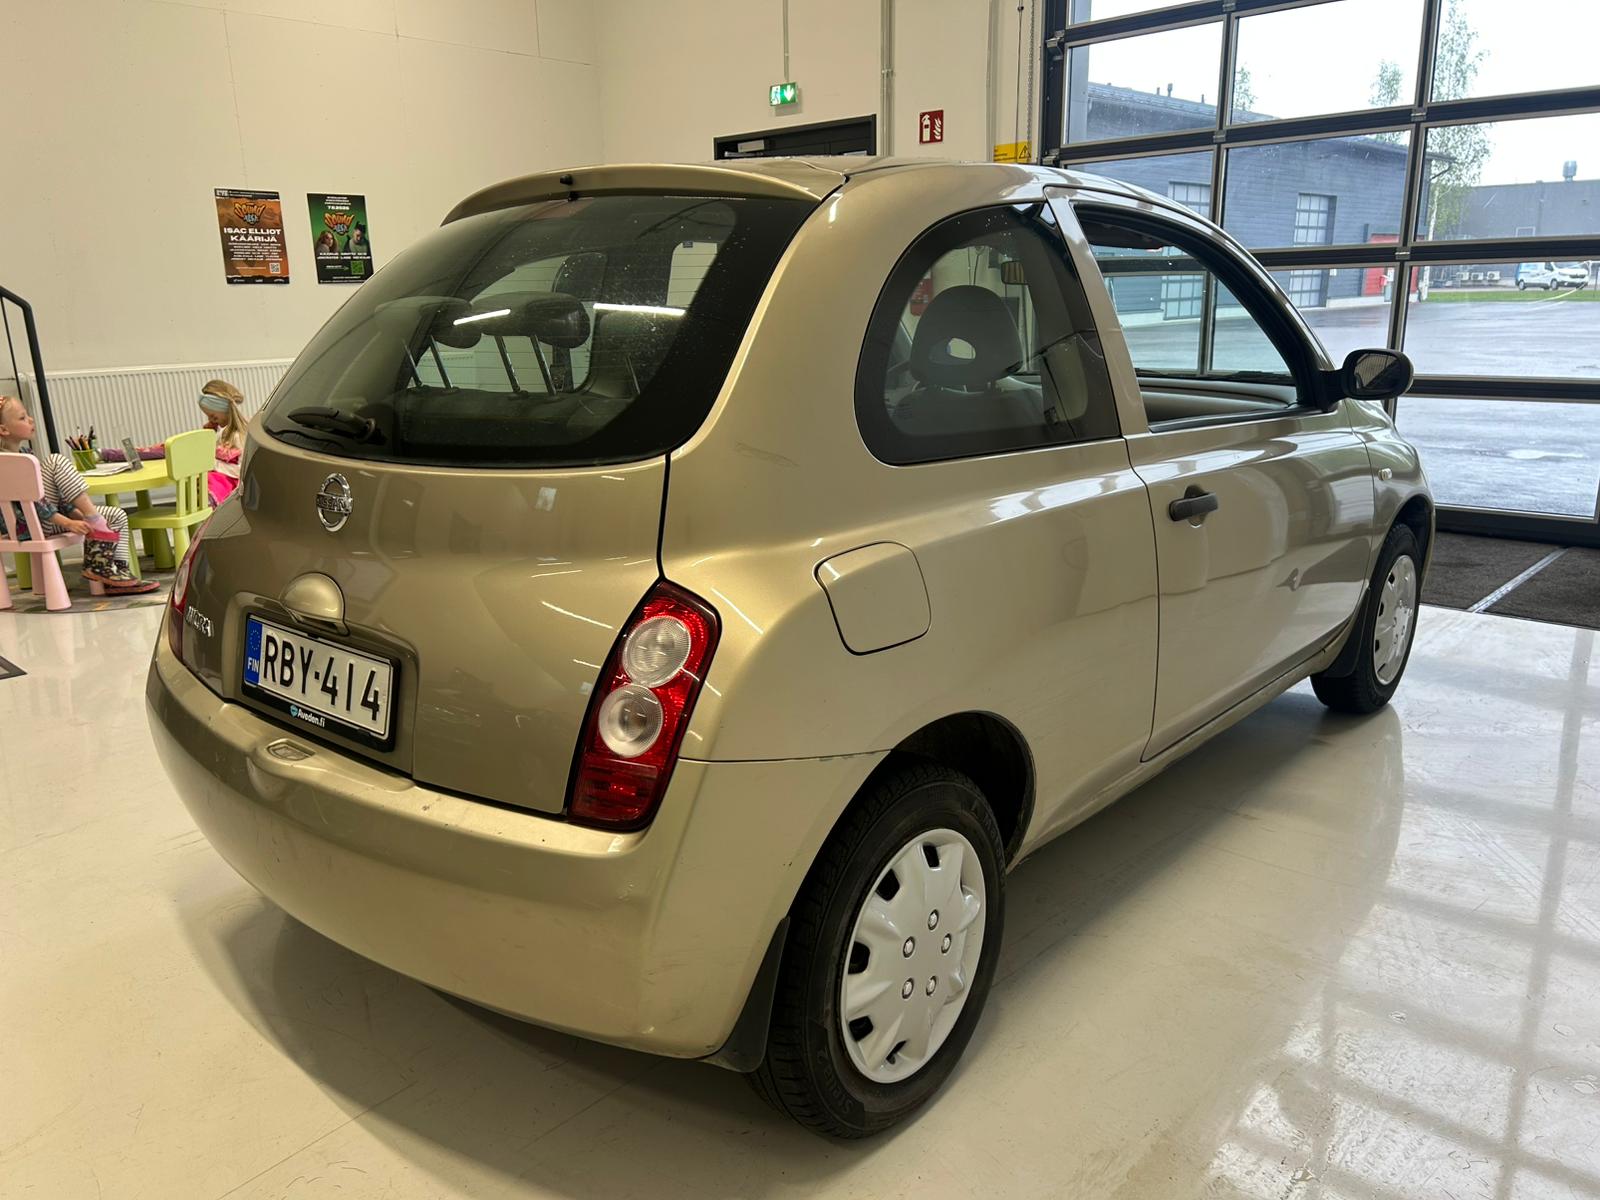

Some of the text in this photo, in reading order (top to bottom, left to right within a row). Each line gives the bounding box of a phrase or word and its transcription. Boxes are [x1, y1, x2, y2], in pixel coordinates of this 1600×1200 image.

[230, 233, 277, 242] KÄÄRIJÄ
[247, 634, 380, 721] FIN RBY-414
[297, 708, 326, 728] Aveden.fi
